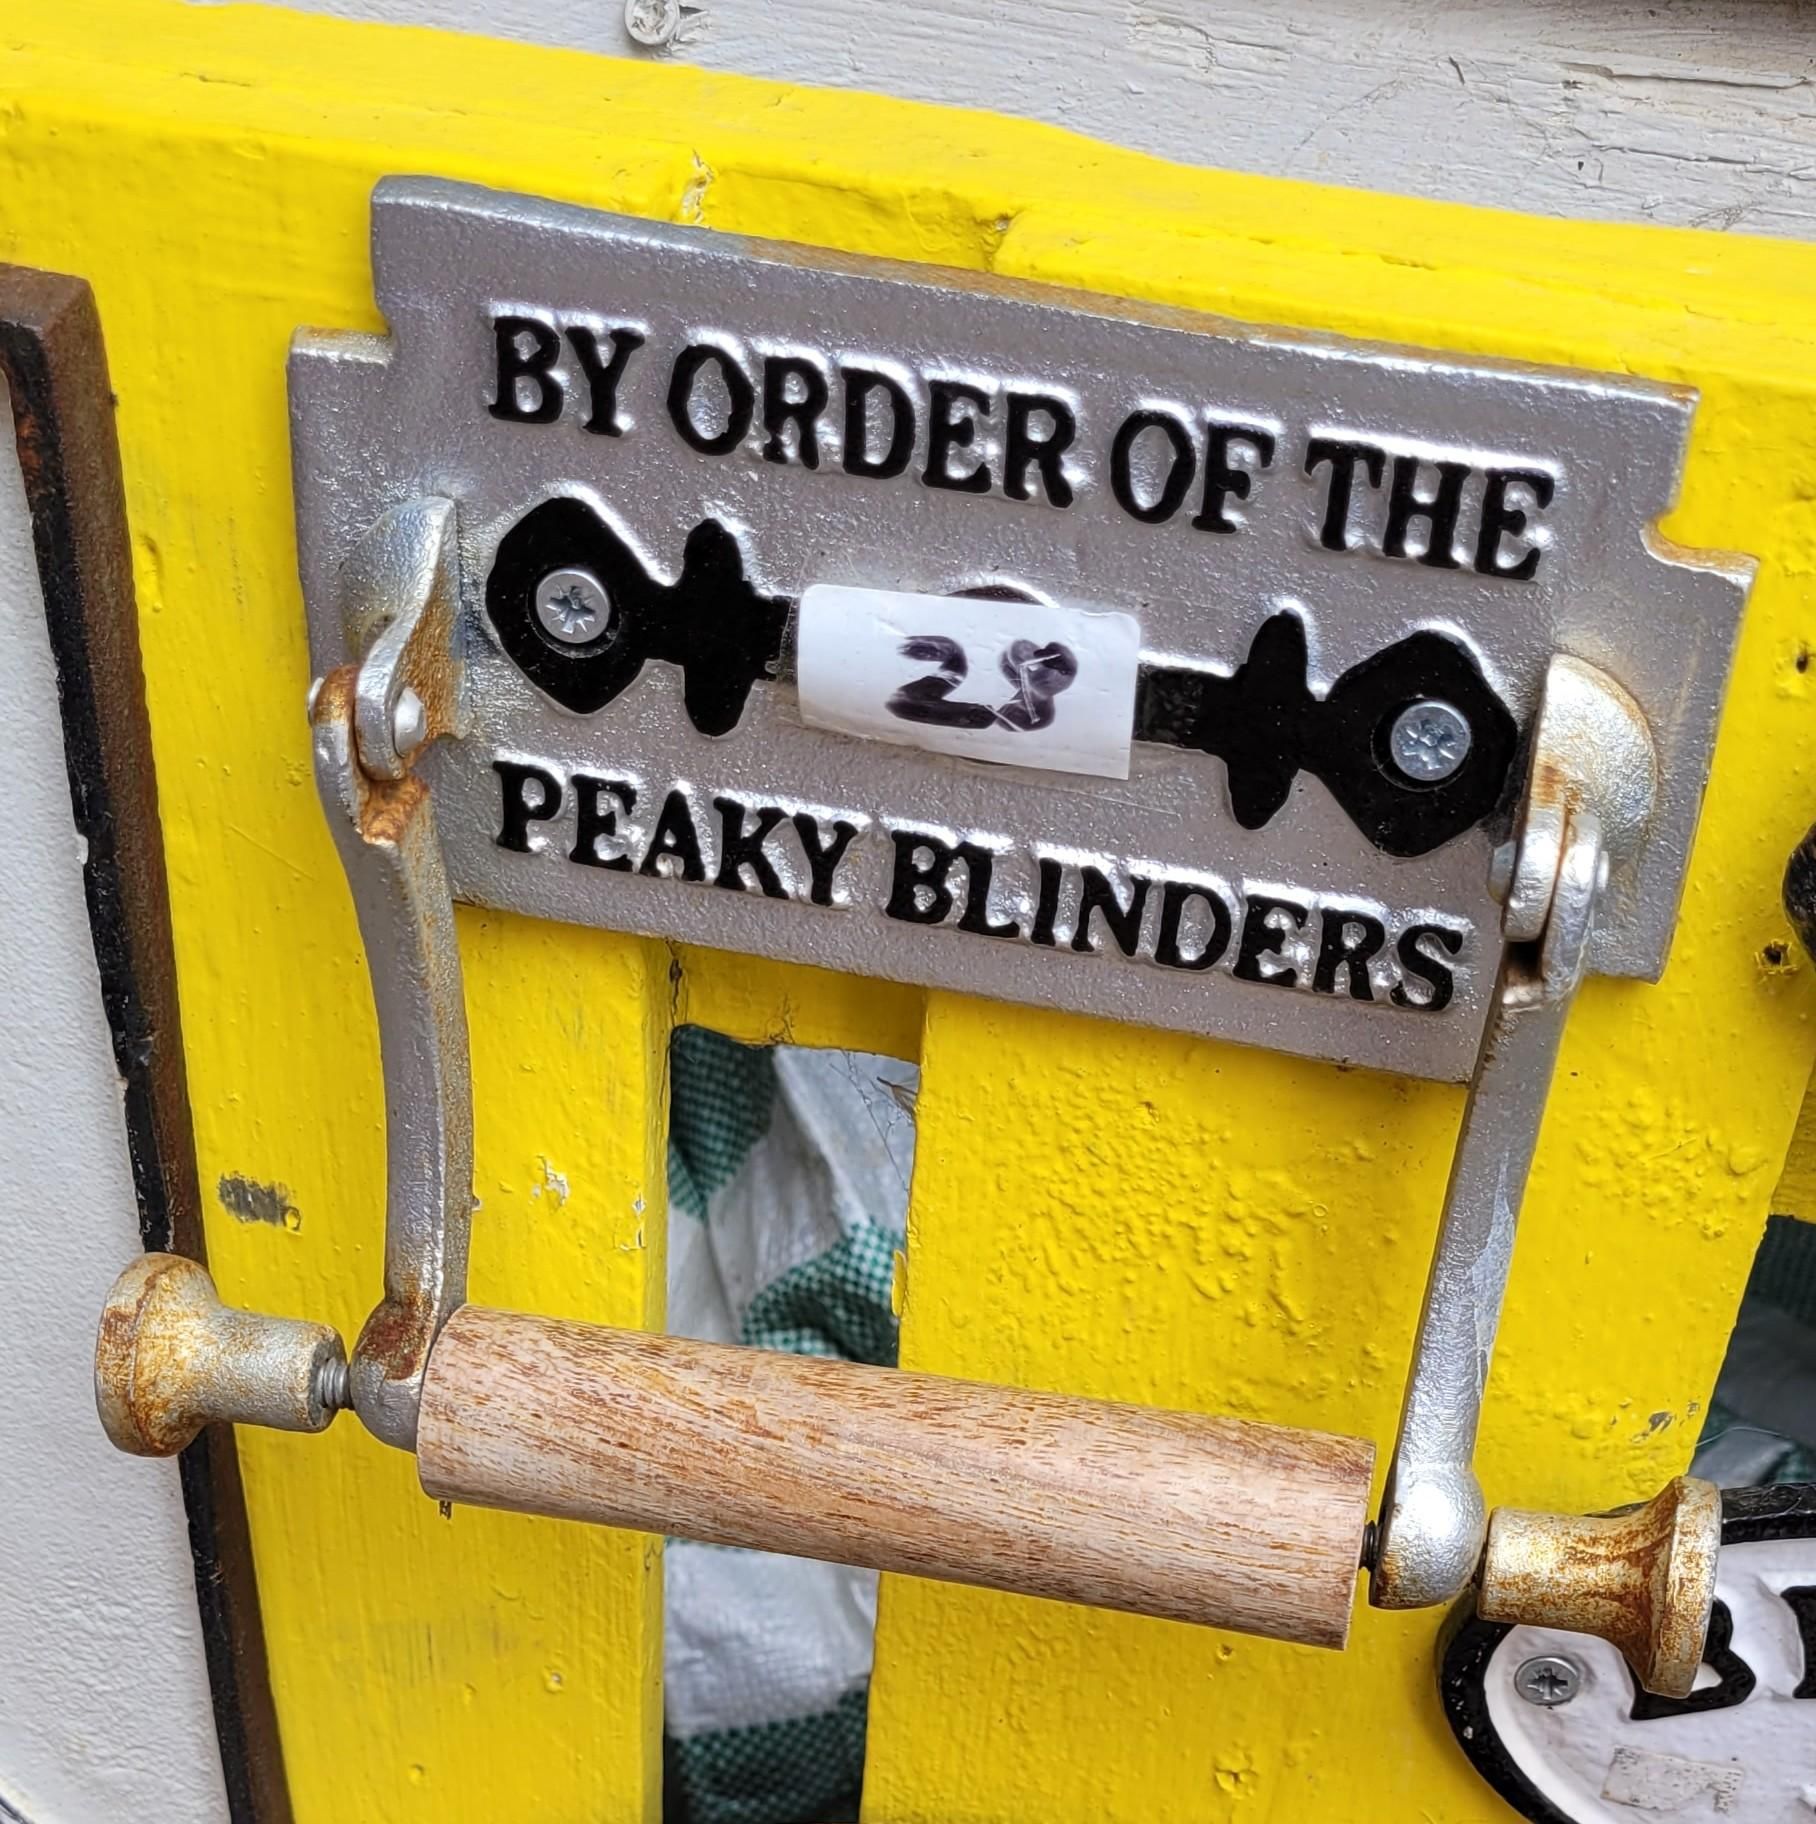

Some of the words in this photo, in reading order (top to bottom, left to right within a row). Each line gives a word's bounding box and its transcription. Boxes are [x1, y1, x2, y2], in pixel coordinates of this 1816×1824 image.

[488, 316, 645, 437] BY
[666, 344, 1076, 508] ORDER
[1110, 409, 1275, 534] OF
[1304, 438, 1555, 581] THE
[885, 635, 1078, 732] 28
[492, 760, 859, 906] PEAKY
[885, 829, 1463, 1011] BLINDERS
